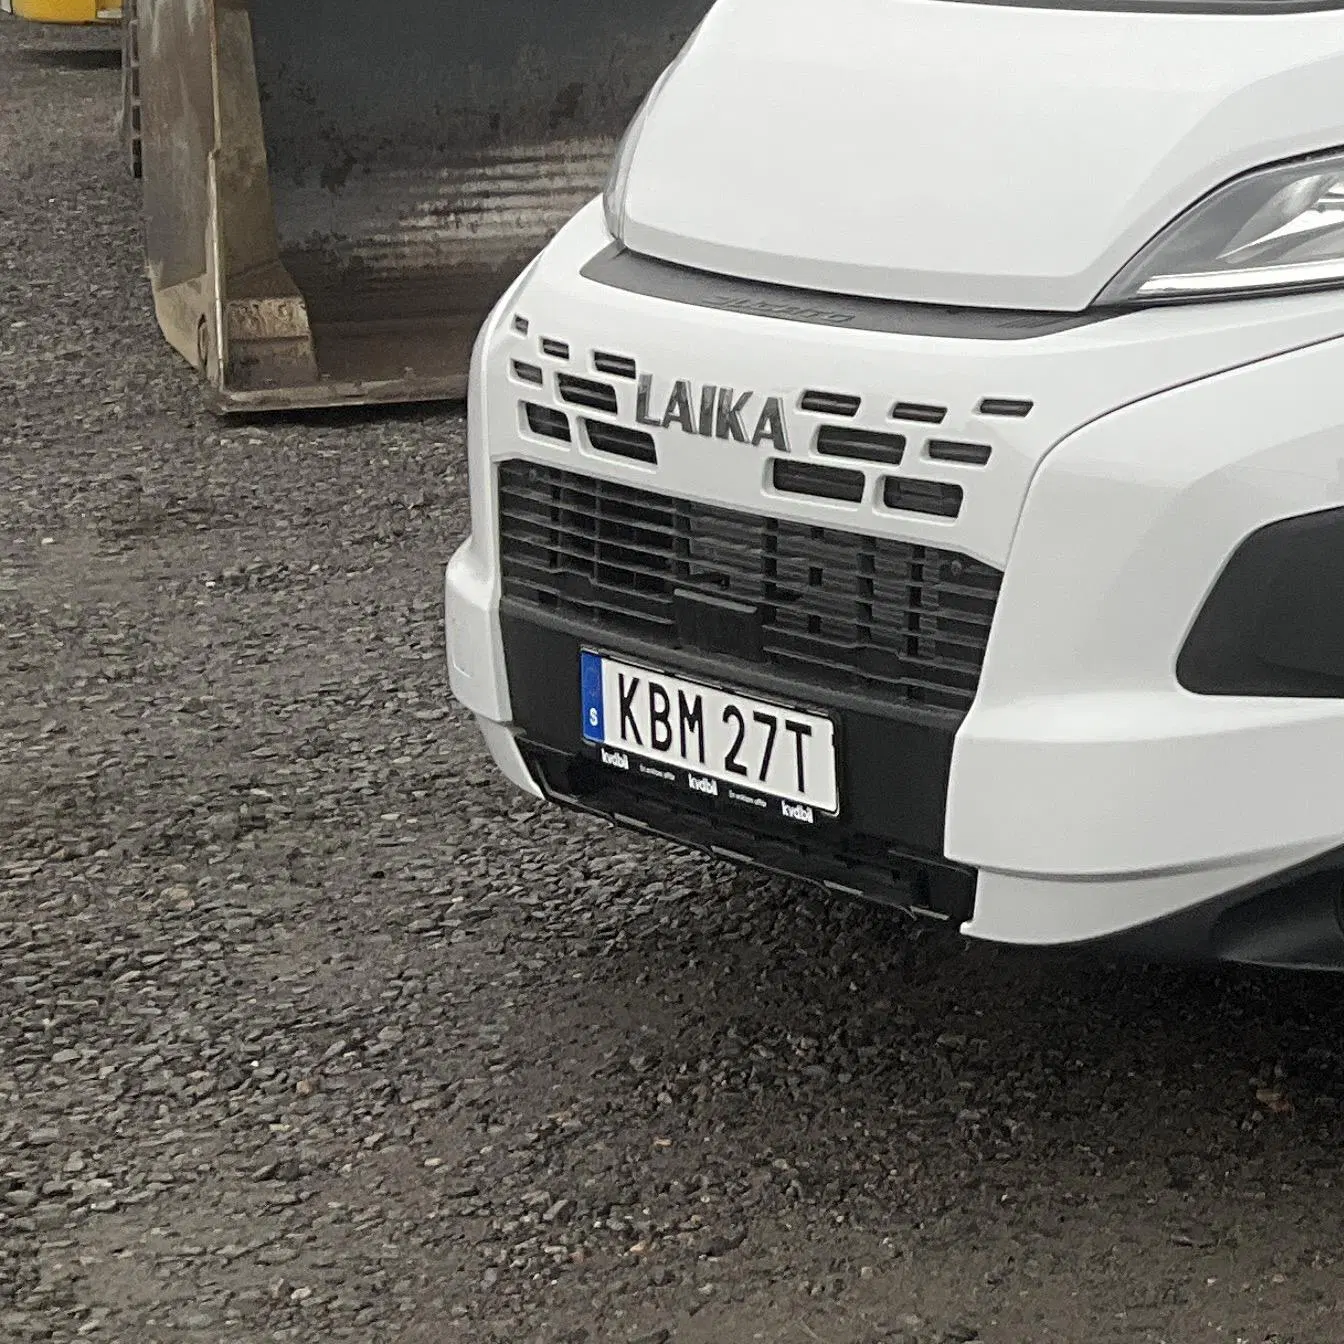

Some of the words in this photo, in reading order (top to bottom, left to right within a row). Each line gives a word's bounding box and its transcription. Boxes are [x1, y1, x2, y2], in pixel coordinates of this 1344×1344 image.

[635, 374, 791, 453] LAIKA
[589, 707, 599, 726] S
[618, 672, 705, 764] KBM
[722, 704, 812, 793] 27T
